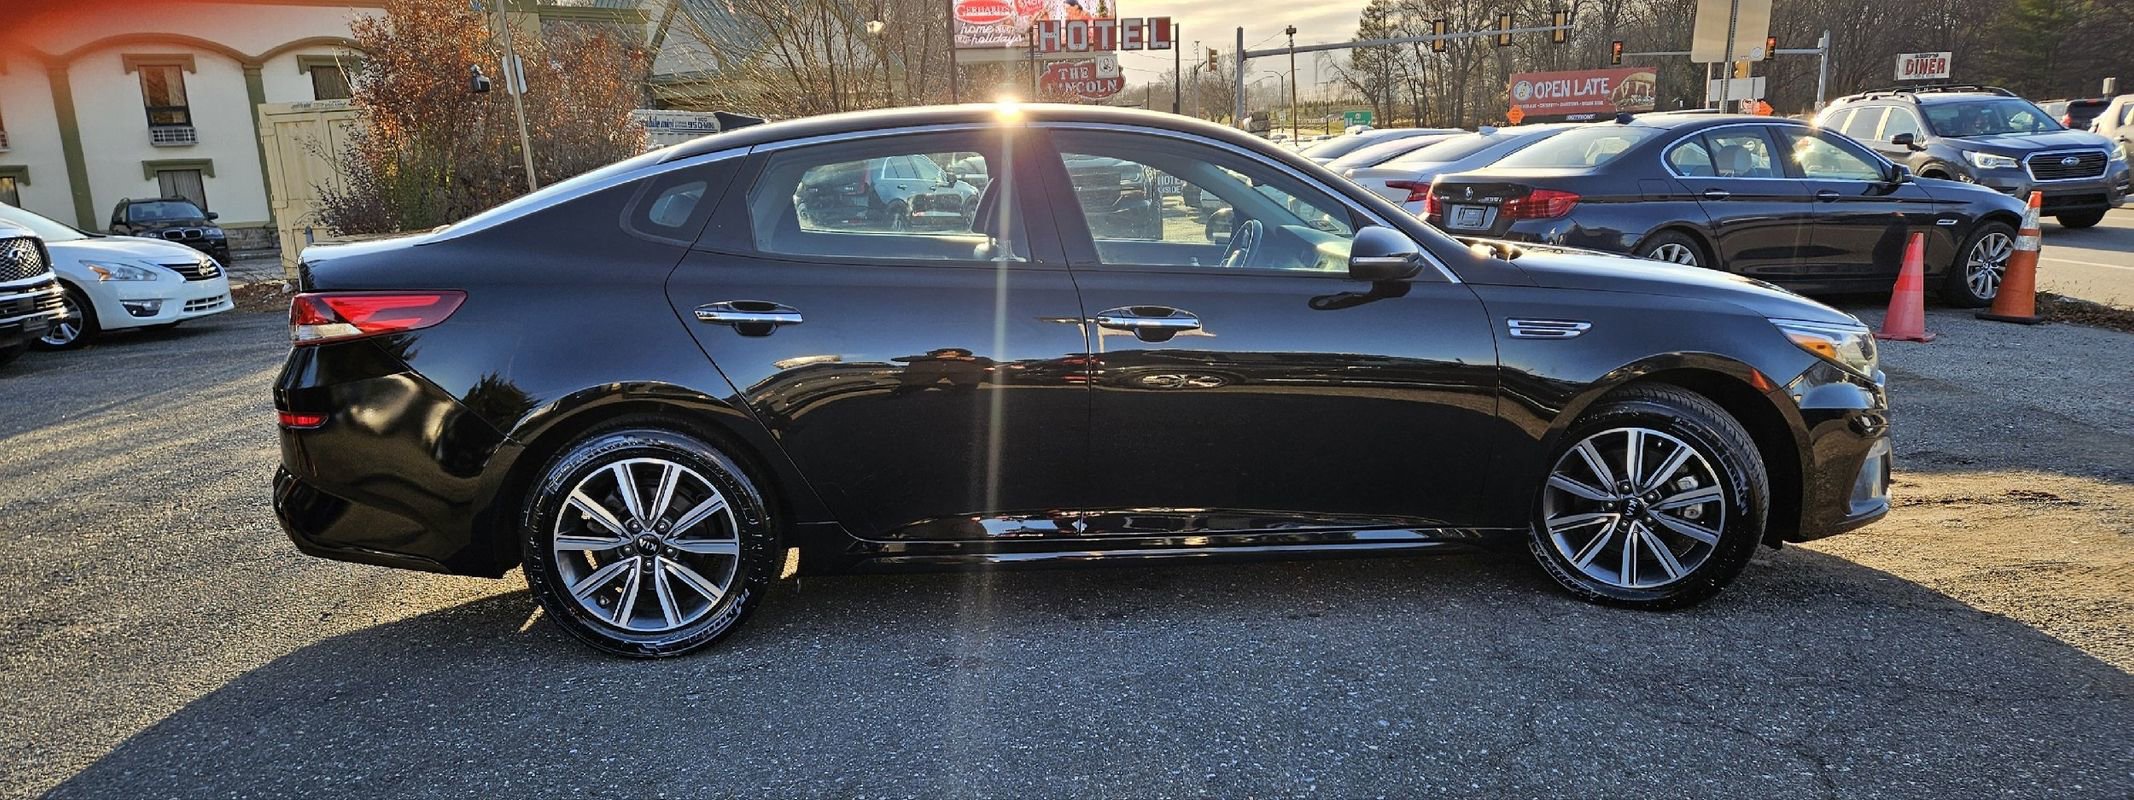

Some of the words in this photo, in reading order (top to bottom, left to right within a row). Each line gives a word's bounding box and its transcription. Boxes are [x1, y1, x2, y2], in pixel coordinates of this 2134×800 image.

[961, 22, 993, 34] home
[1040, 18, 1170, 51] HOTEL
[1058, 67, 1088, 80] THE
[1905, 58, 1946, 75] DINER
[1534, 80, 1571, 99] OPEN
[1574, 77, 1610, 96] LATE
[1625, 500, 1637, 516] KIA
[638, 538, 657, 551] KIA
